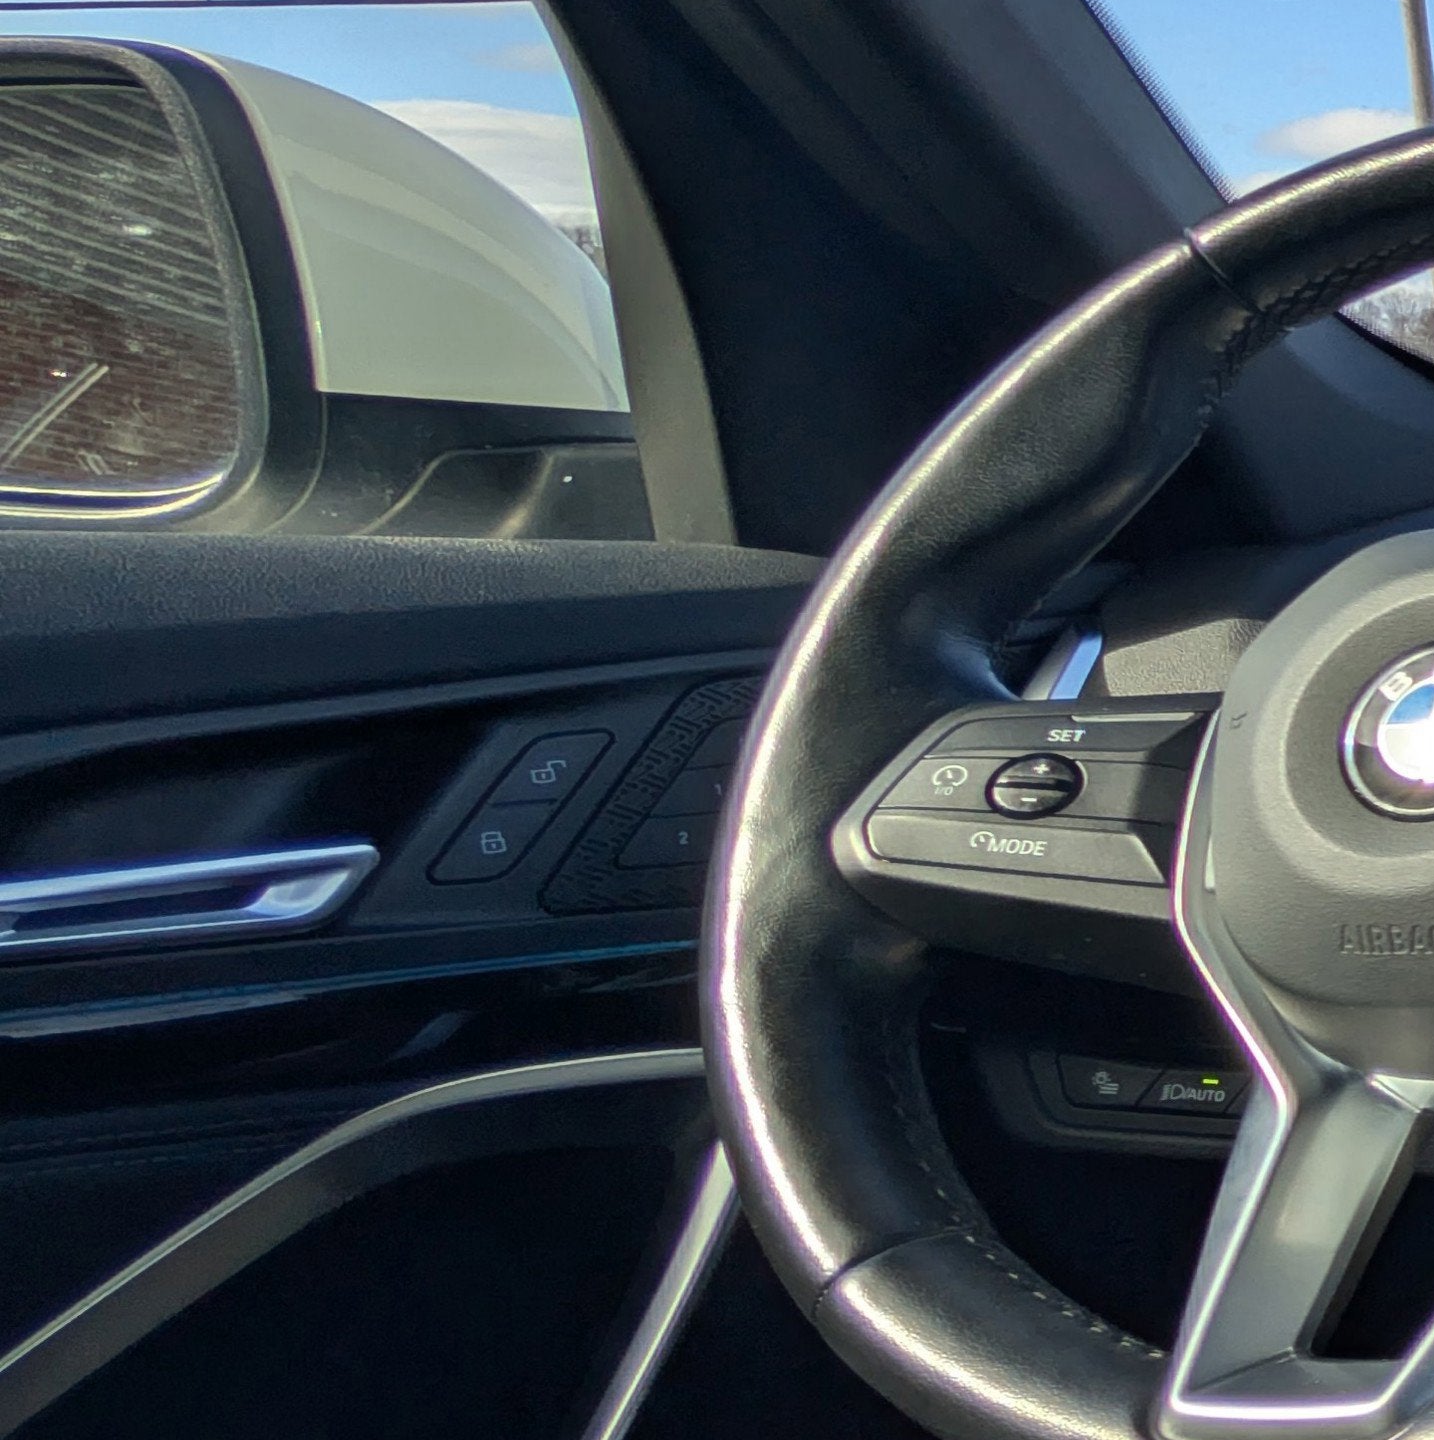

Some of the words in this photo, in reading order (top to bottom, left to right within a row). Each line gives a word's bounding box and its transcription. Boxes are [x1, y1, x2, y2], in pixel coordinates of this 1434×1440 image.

[1047, 729, 1086, 742] SET
[678, 830, 689, 845] 2
[987, 838, 1047, 856] MODE
